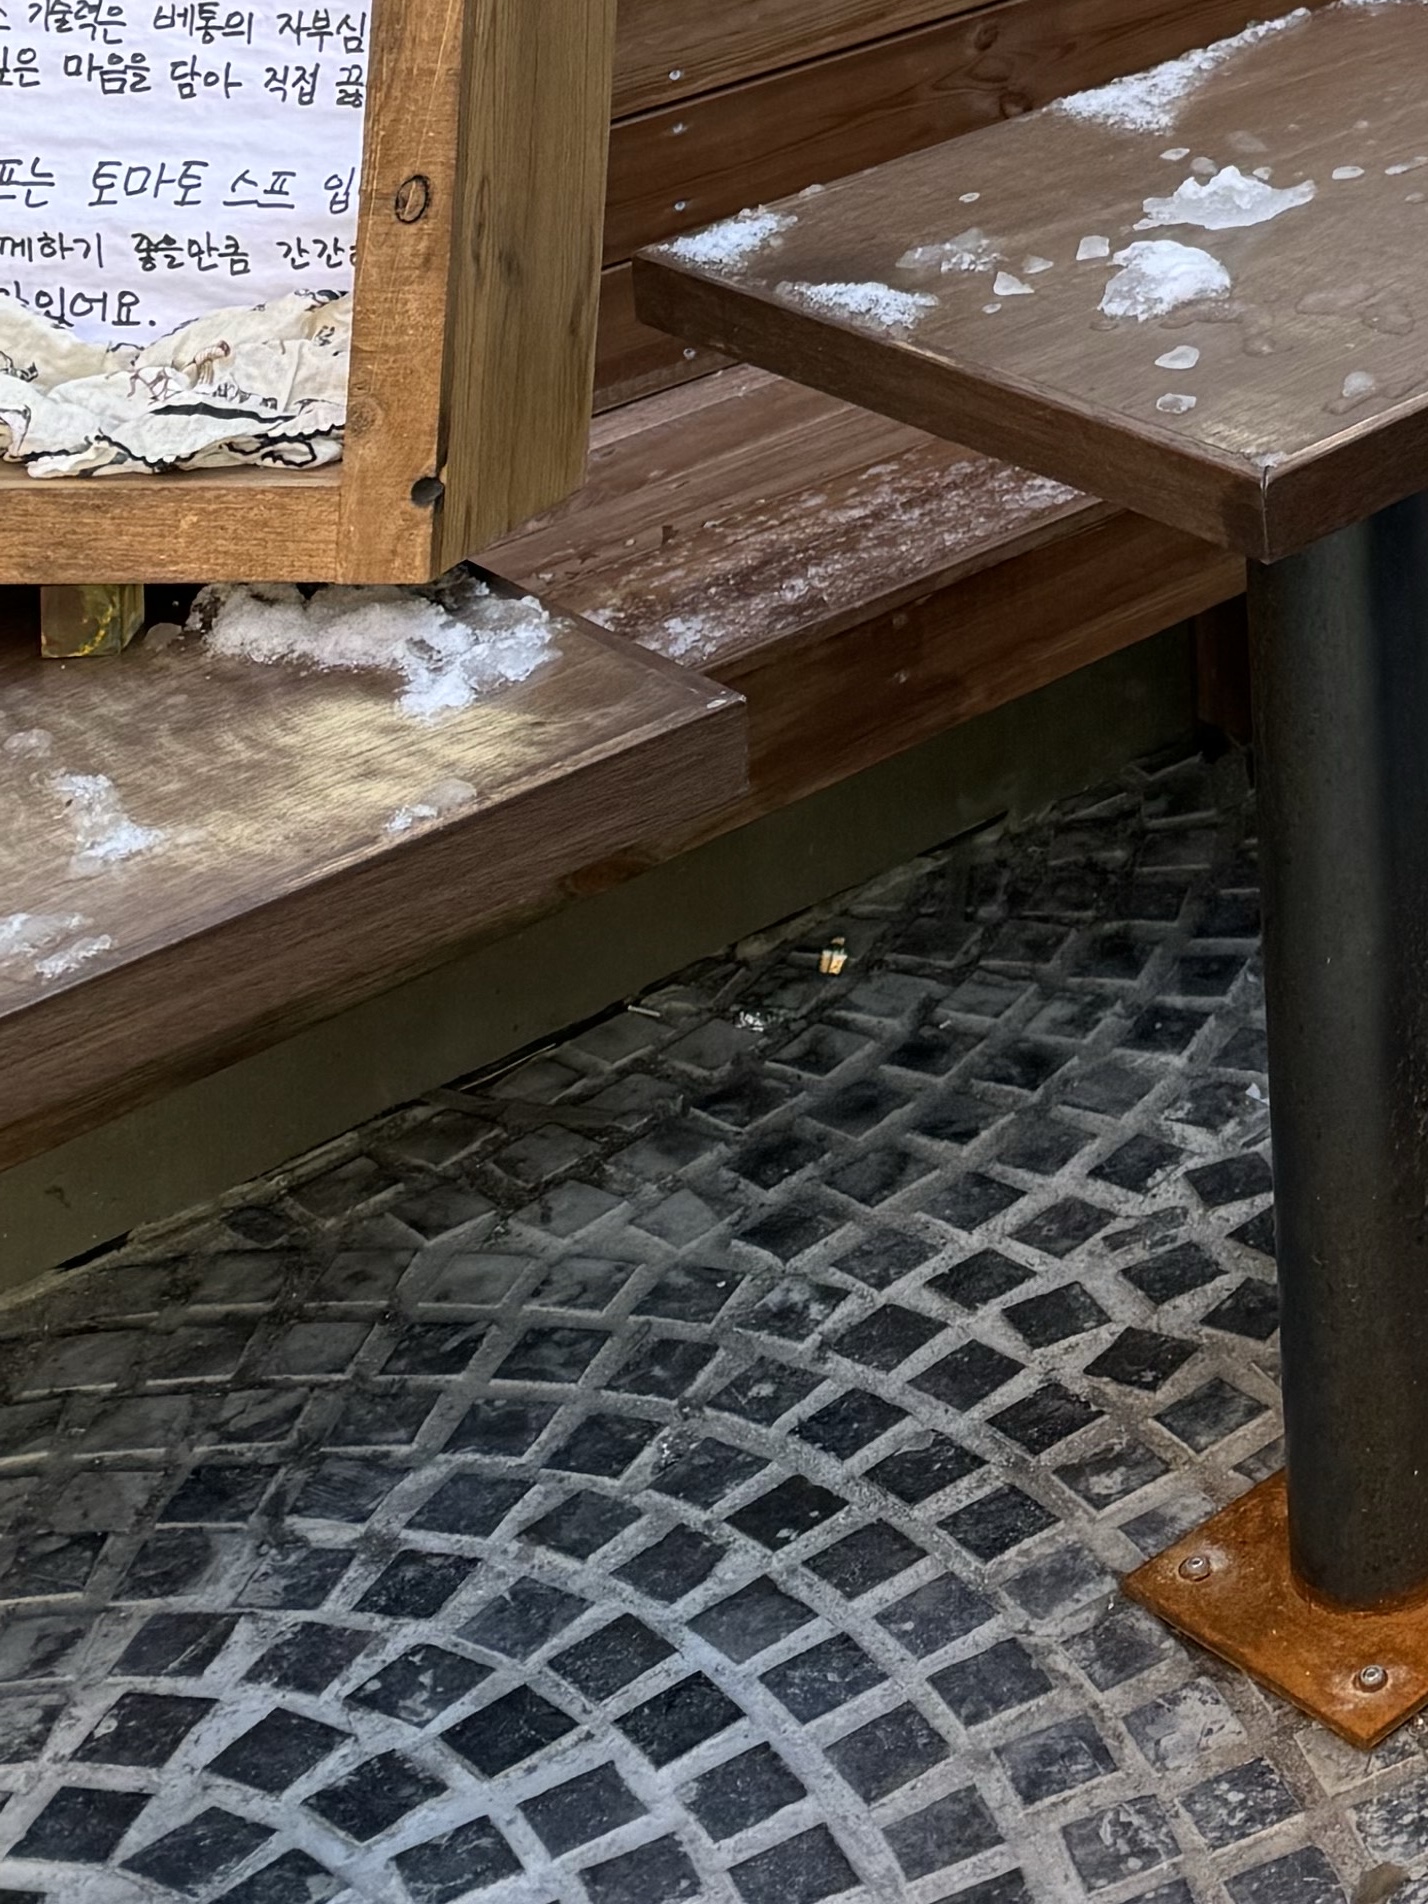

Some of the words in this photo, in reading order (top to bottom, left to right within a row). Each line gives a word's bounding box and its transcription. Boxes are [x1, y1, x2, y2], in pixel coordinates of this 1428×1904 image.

[153, 1, 254, 45] 베통의
[276, 8, 366, 54] 자부심
[63, 52, 152, 95] 마음을
[170, 54, 243, 100] 담아
[264, 62, 321, 106] 직접
[88, 160, 209, 208] 토마토
[222, 169, 297, 210] 스프
[323, 166, 356, 215] 입
[131, 231, 251, 276] 좋을만큼
